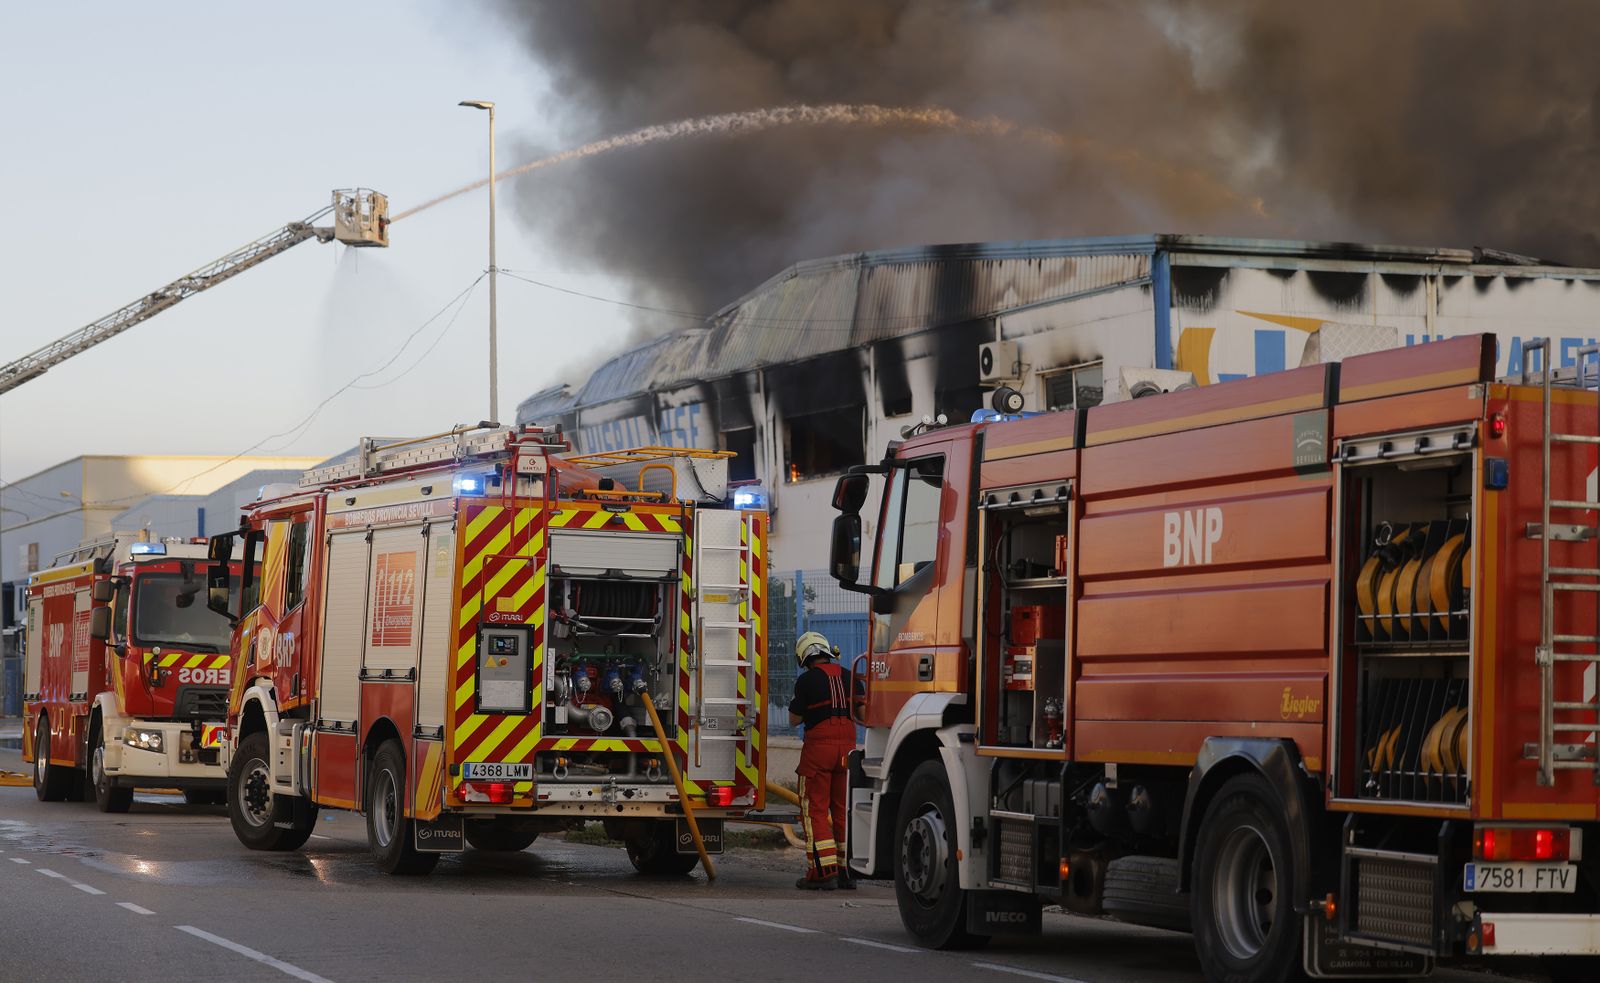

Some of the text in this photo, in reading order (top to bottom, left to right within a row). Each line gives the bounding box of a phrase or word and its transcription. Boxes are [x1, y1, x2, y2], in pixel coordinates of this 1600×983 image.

[586, 403, 701, 454] HISPALNSE
[344, 502, 434, 526] BOMBEROS PROVINCIA SEVILLA
[1163, 507, 1223, 568] BNP
[388, 568, 414, 606] 112
[472, 765, 530, 777] 4368 LMW
[1480, 868, 1569, 889] 7581 FTV
[986, 911, 1027, 922] IVECO
[1330, 959, 1371, 968] CARMONA
